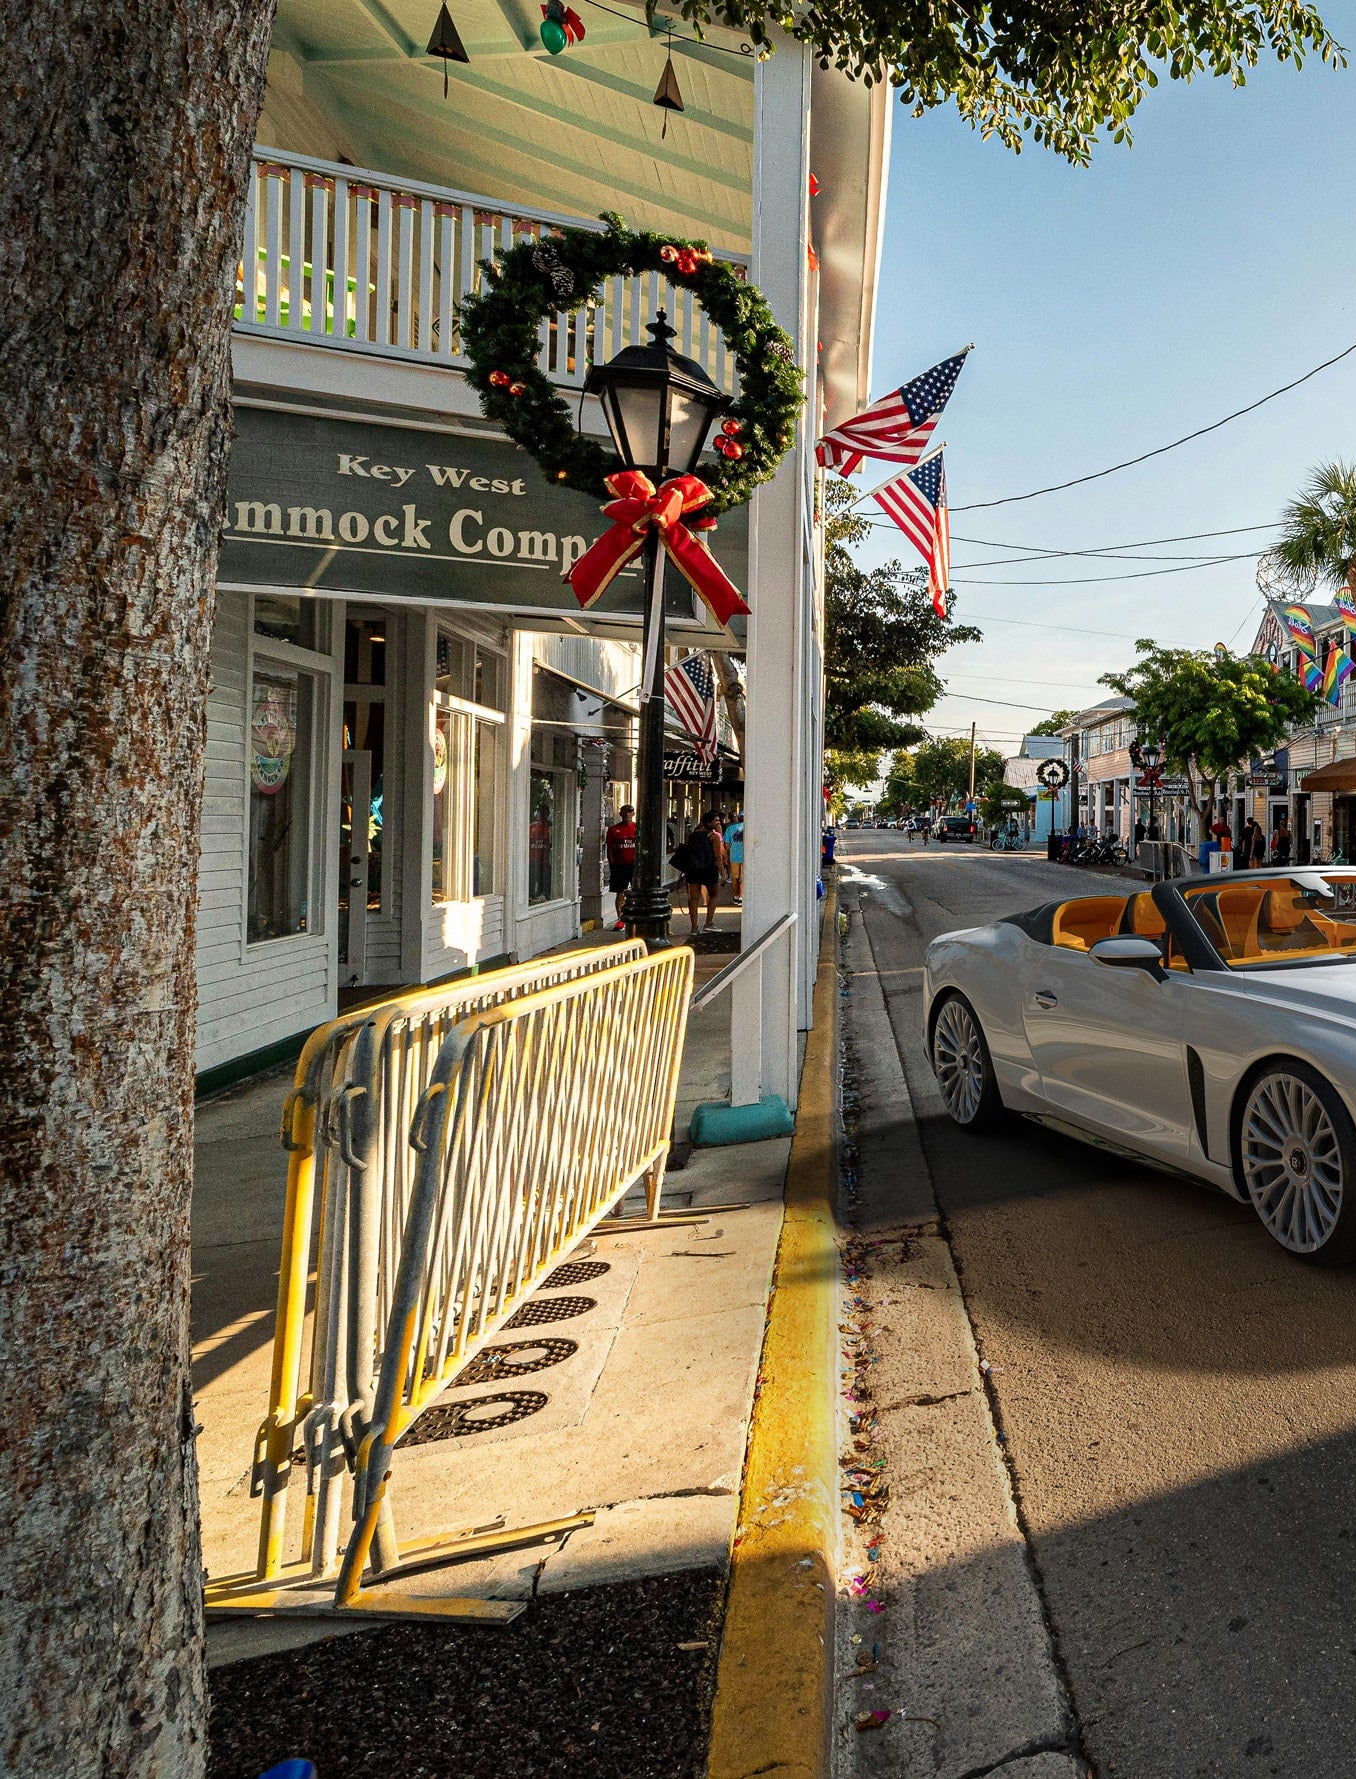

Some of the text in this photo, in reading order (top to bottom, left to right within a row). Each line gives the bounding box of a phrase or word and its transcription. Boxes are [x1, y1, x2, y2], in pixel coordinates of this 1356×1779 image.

[336, 453, 527, 496] Key West
[226, 501, 644, 576] mmock Comp
